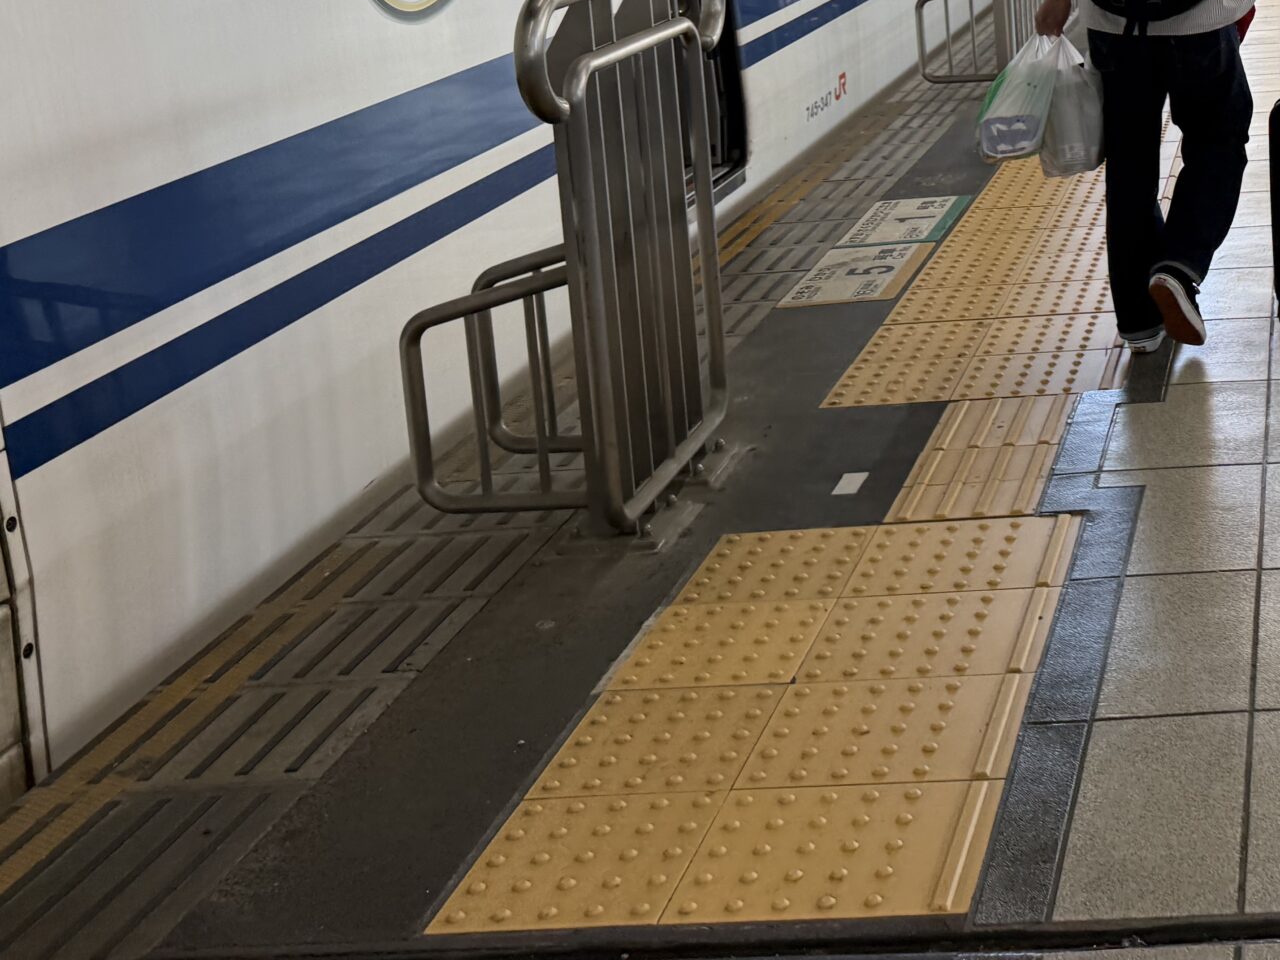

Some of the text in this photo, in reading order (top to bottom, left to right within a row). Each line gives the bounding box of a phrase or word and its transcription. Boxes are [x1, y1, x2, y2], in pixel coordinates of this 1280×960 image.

[834, 71, 847, 101] JR
[894, 215, 936, 223] 1
[845, 265, 895, 276] 5
